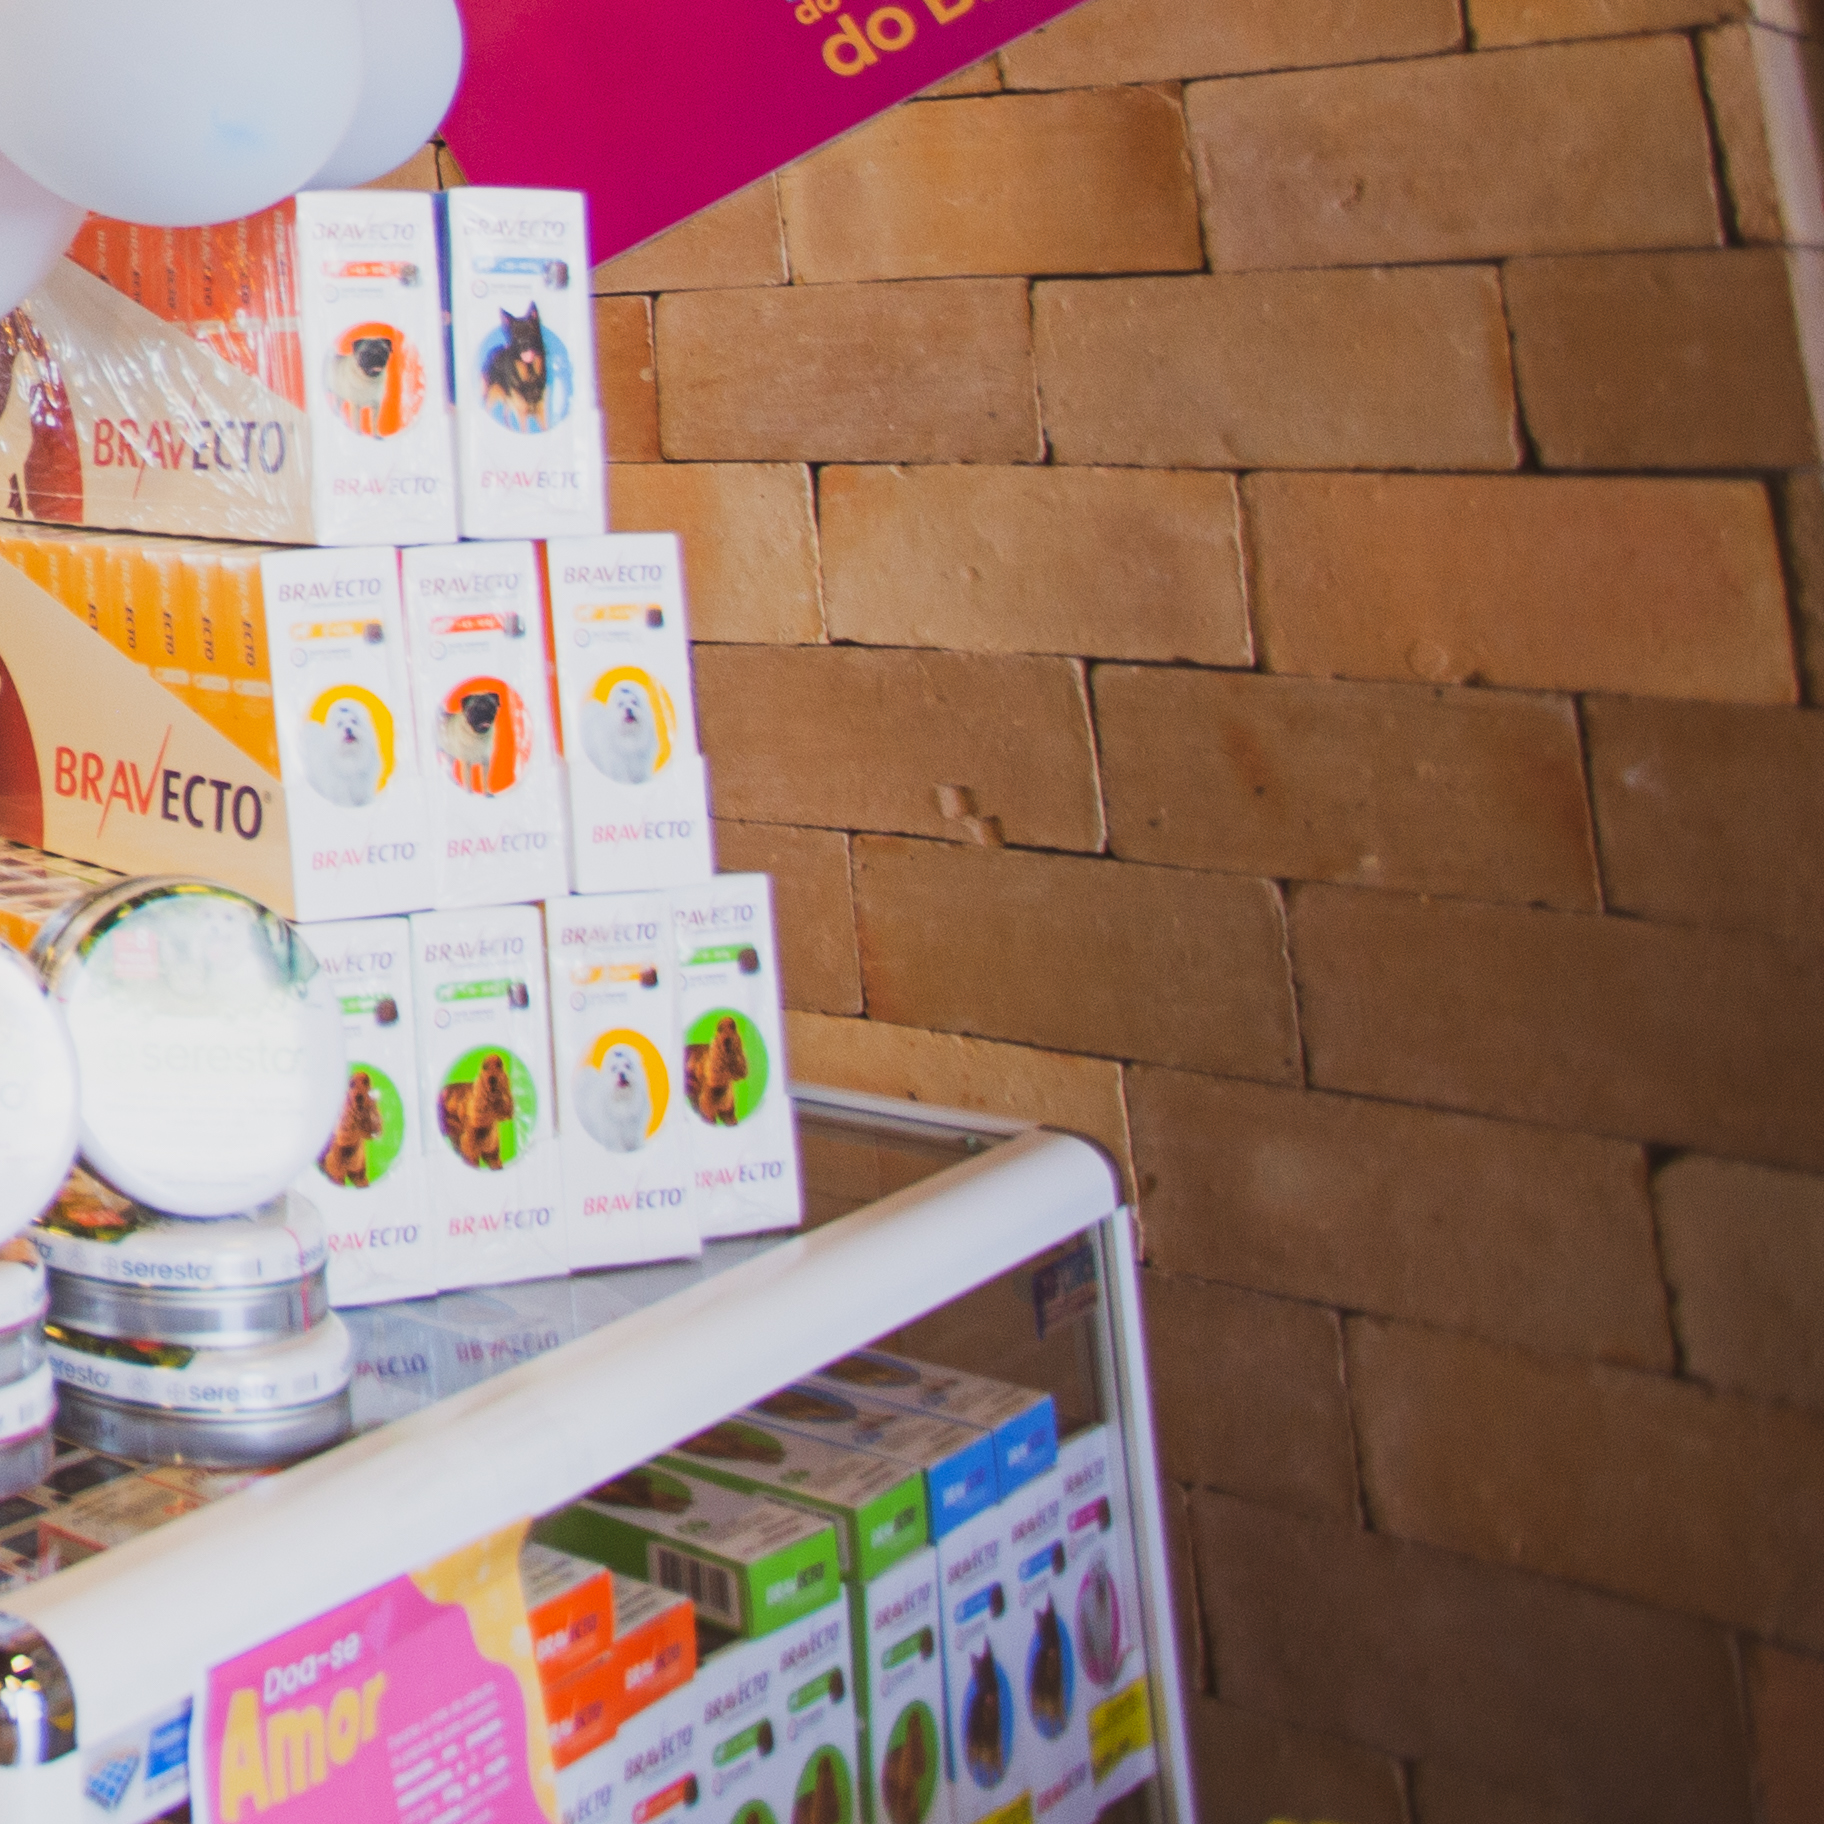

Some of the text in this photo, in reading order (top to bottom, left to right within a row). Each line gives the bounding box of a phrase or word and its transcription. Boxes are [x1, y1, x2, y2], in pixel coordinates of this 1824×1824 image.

[821, 6, 918, 77] do
[93, 401, 288, 486] BRAVECTO
[54, 734, 264, 840] BRAVECTO
[447, 829, 547, 860] BRAVECTO
[591, 816, 691, 846] BRAVECTO
[312, 840, 415, 873] BRAVECTO
[583, 1185, 684, 1220] BRAVECTO
[448, 1204, 551, 1239] BRAVECTO
[121, 1257, 212, 1282] seresto
[263, 1632, 362, 1705] Doa-se
[220, 1671, 387, 1823] Amor
